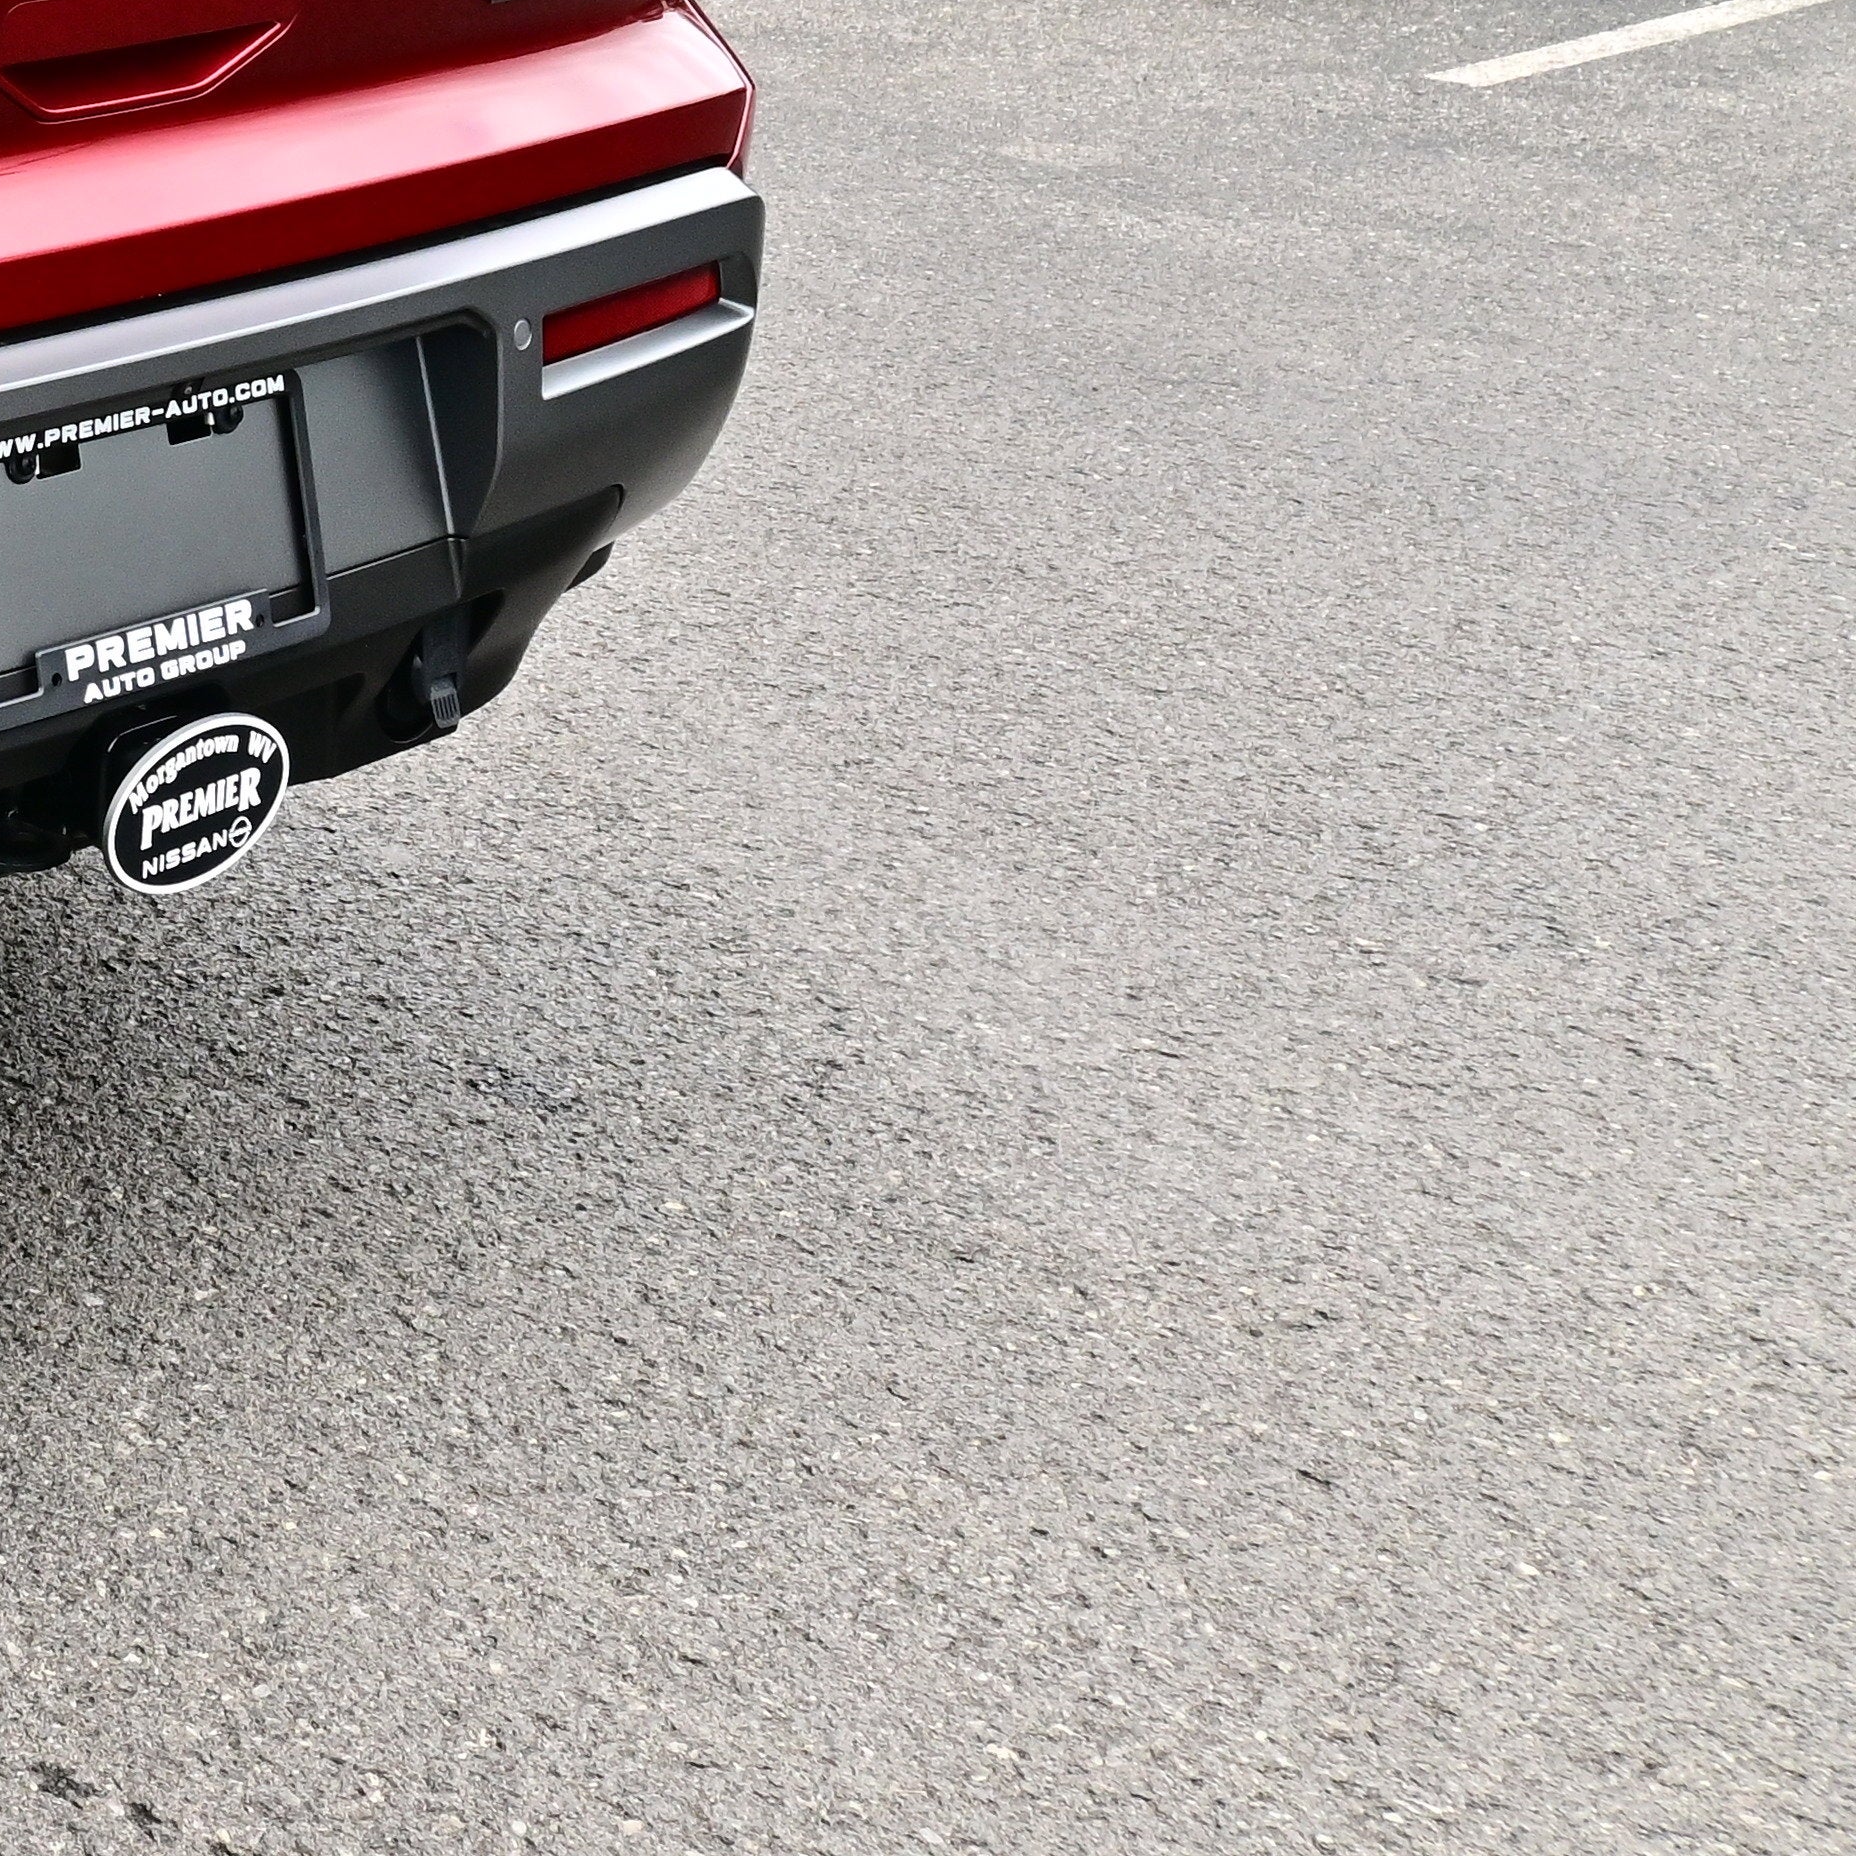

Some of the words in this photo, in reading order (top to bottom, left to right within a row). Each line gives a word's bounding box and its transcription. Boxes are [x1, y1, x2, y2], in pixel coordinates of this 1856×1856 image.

[64, 599, 255, 683] PREMIER
[84, 666, 156, 704] AUTO
[160, 639, 247, 681] GROUP
[128, 734, 240, 815] Morgantown
[247, 730, 278, 764] WV
[139, 767, 262, 851] PREMIER
[141, 829, 228, 880] NISSAN
